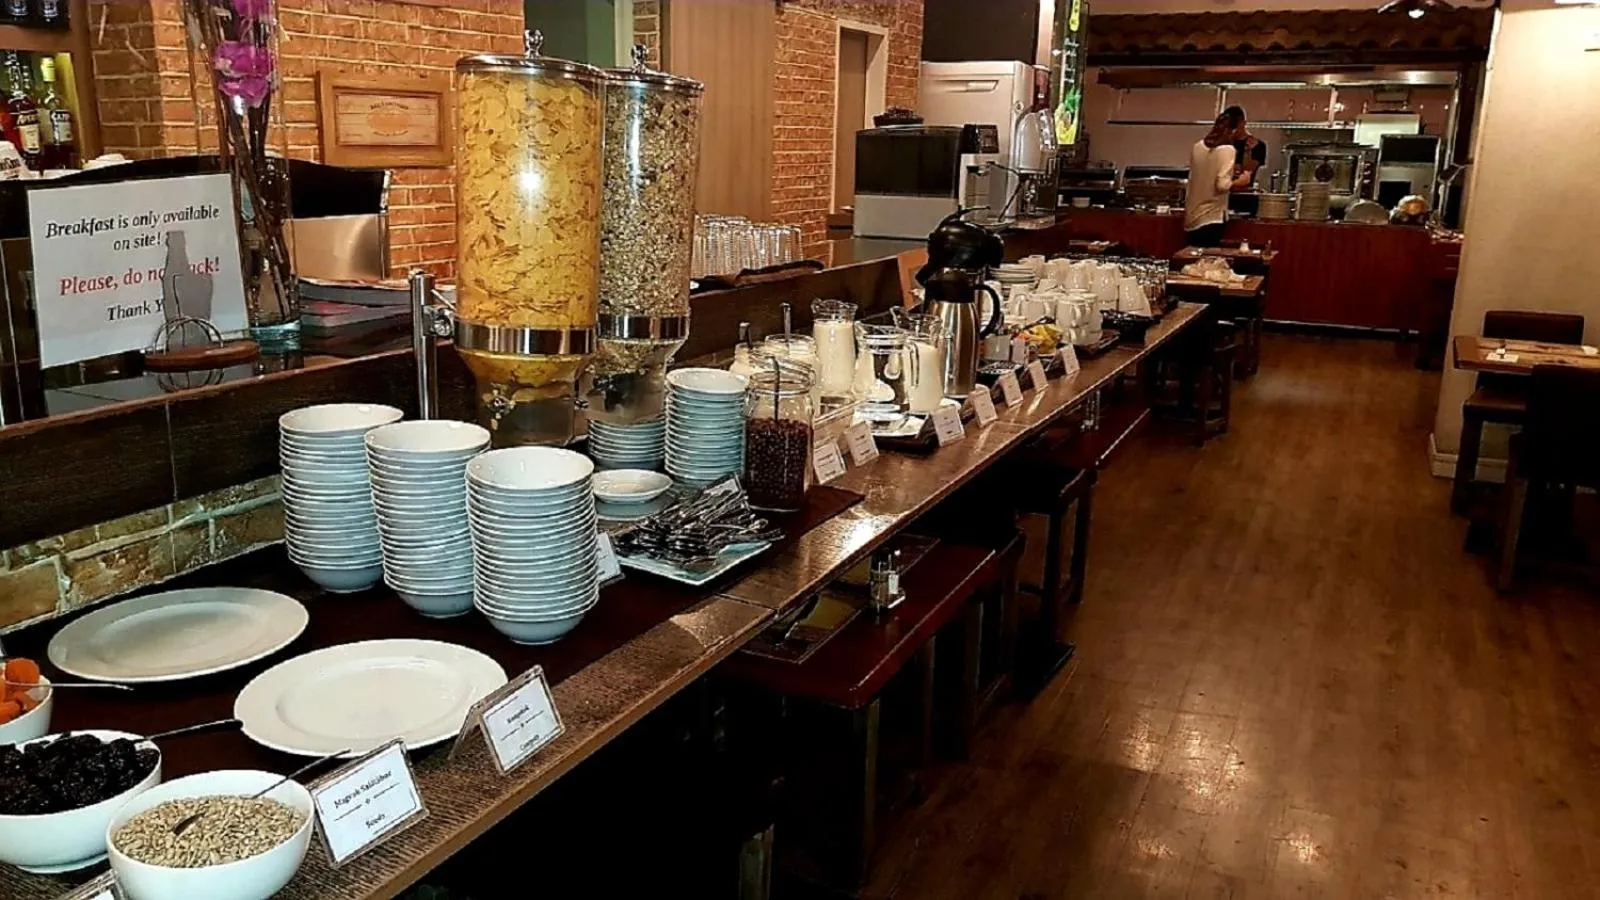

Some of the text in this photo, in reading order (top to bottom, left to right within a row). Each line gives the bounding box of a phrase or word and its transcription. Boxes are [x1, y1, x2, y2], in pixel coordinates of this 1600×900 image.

[45, 205, 220, 239] Breakfast is only available
[113, 232, 161, 251] on site!
[60, 274, 119, 296] Please,
[123, 268, 143, 286] do
[148, 267, 165, 282] no
[107, 300, 151, 321] Thank
